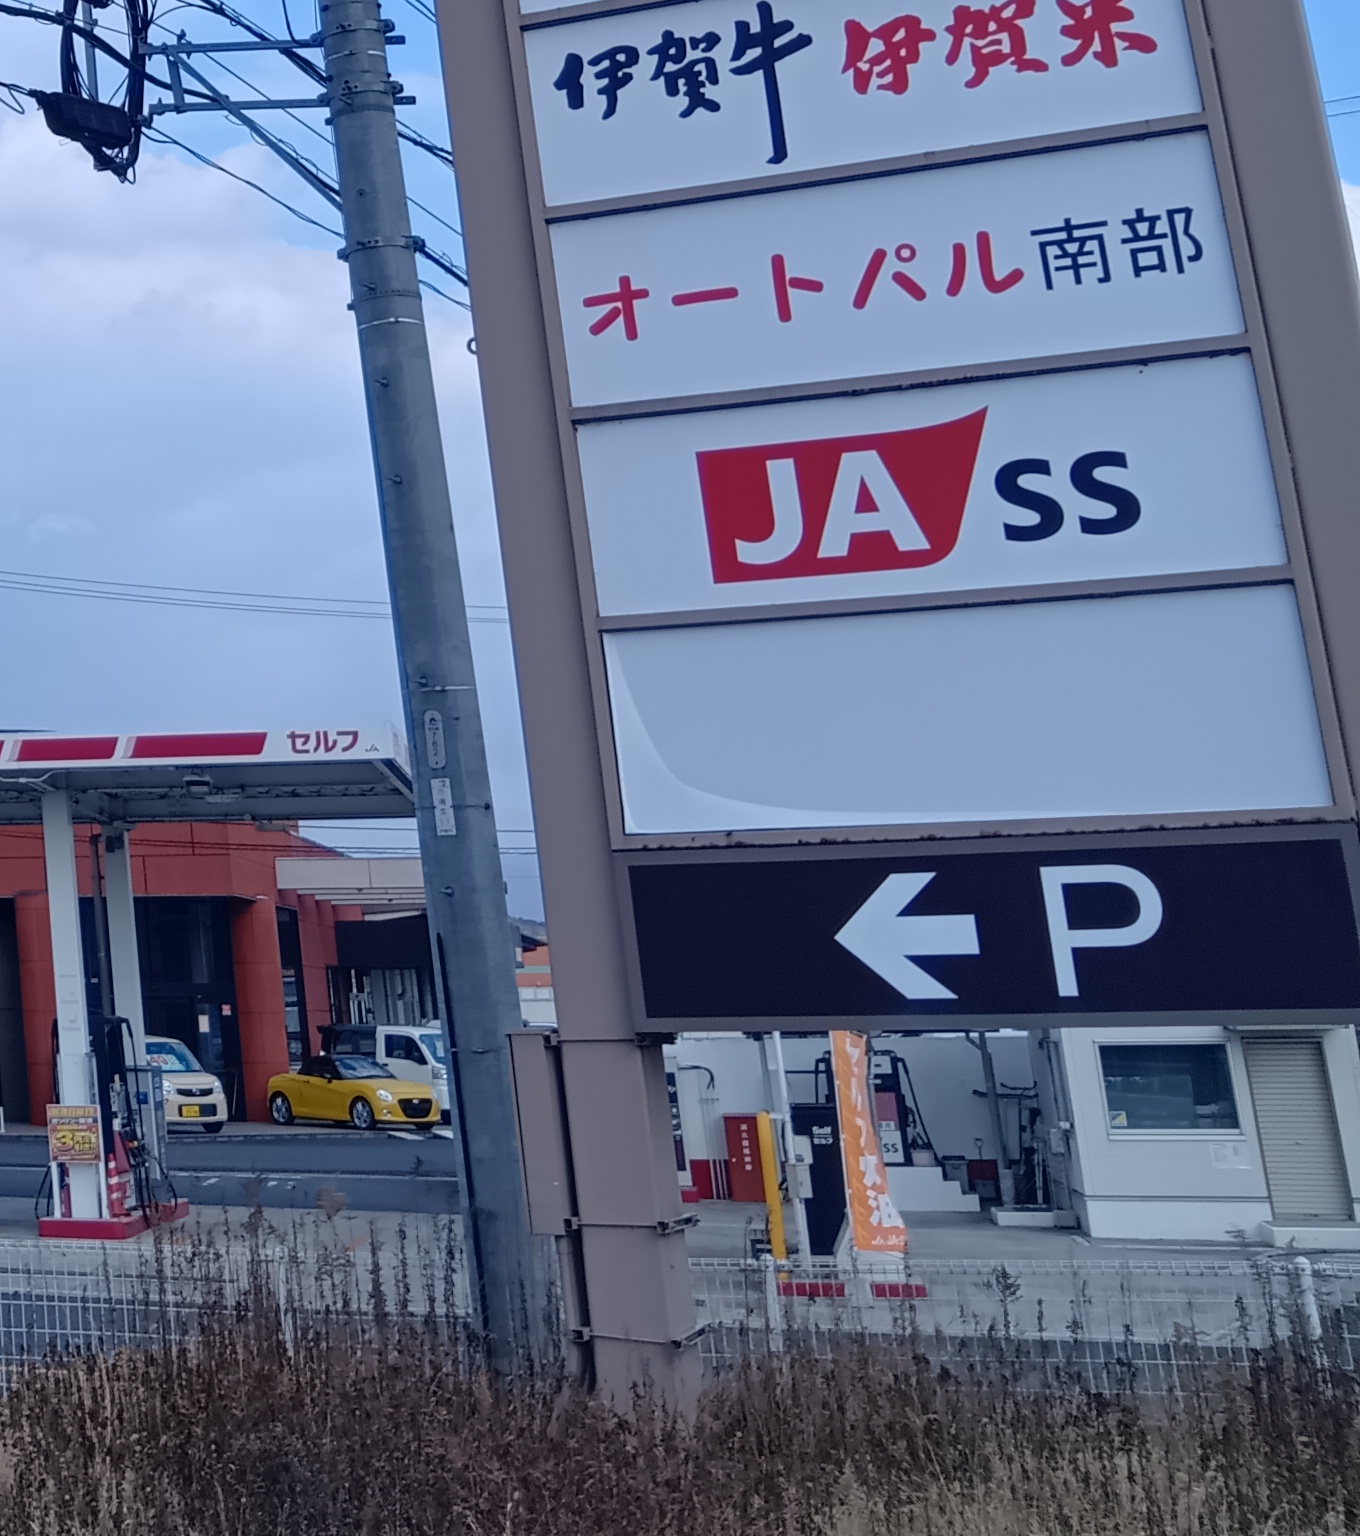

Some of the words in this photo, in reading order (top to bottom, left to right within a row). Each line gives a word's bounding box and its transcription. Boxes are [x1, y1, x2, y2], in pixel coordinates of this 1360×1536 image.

[553, 1, 813, 166] 伊賀牛
[733, 448, 932, 566] JA
[286, 730, 359, 754] セルフ
[1038, 863, 1164, 998] P
